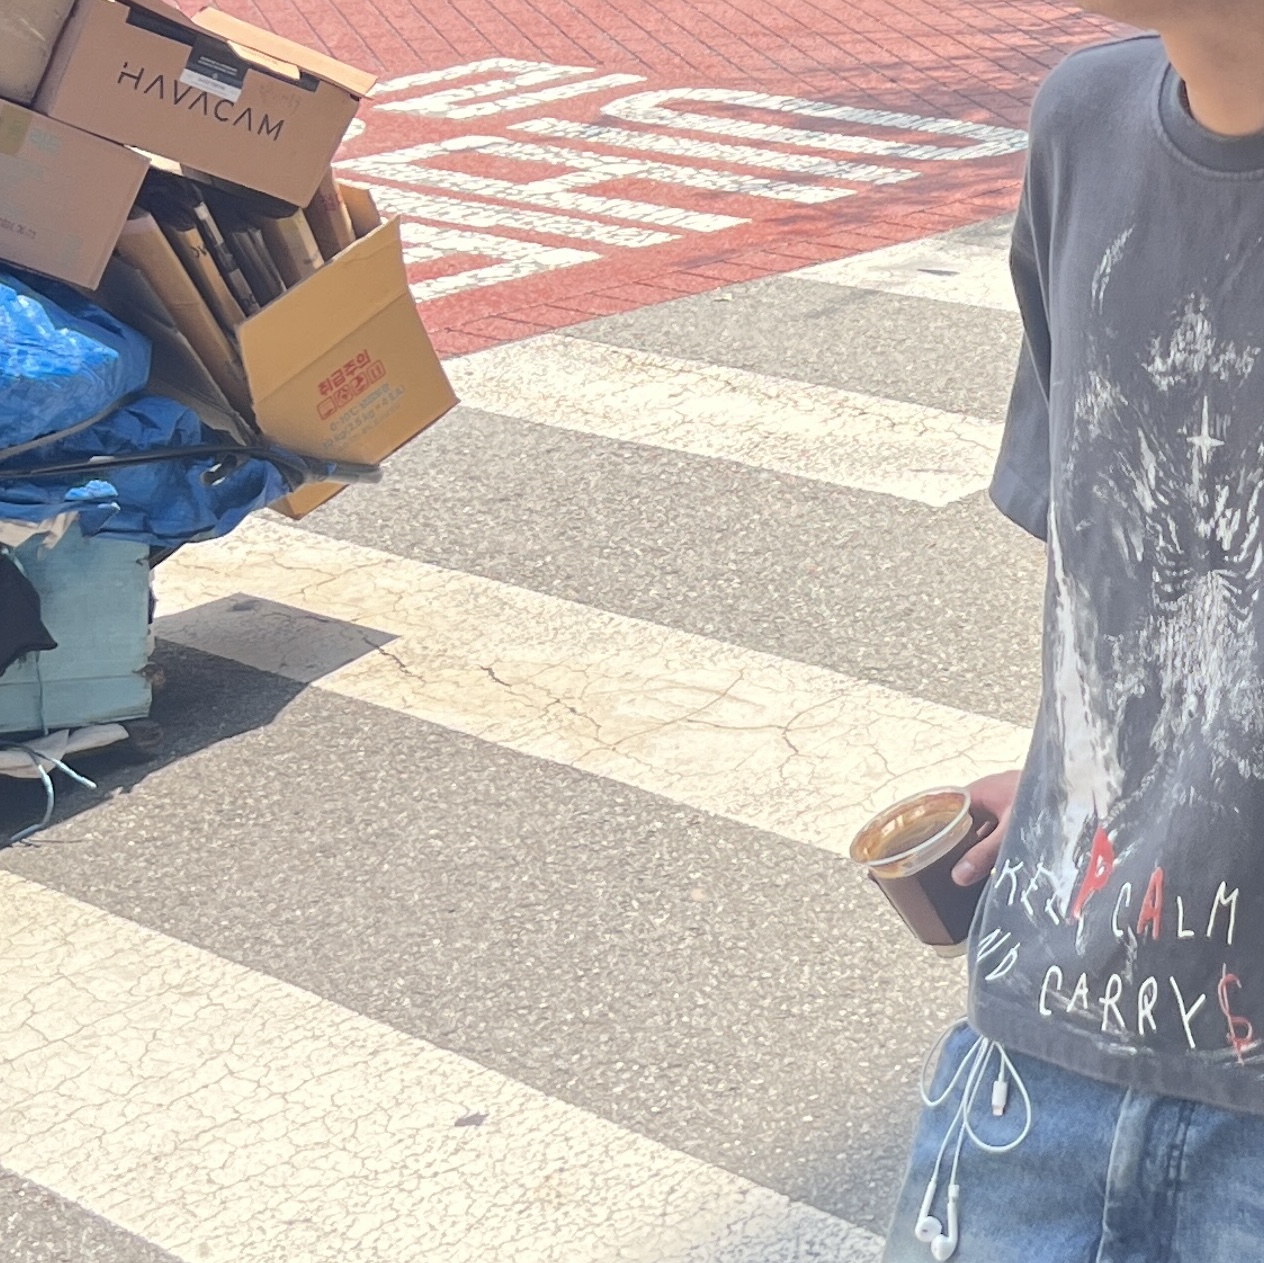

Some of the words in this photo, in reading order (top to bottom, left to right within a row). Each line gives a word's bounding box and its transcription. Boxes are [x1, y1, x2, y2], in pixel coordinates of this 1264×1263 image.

[117, 61, 285, 142] HAVACAM
[317, 348, 371, 396] 취급주의
[1112, 865, 1240, 945] CALM
